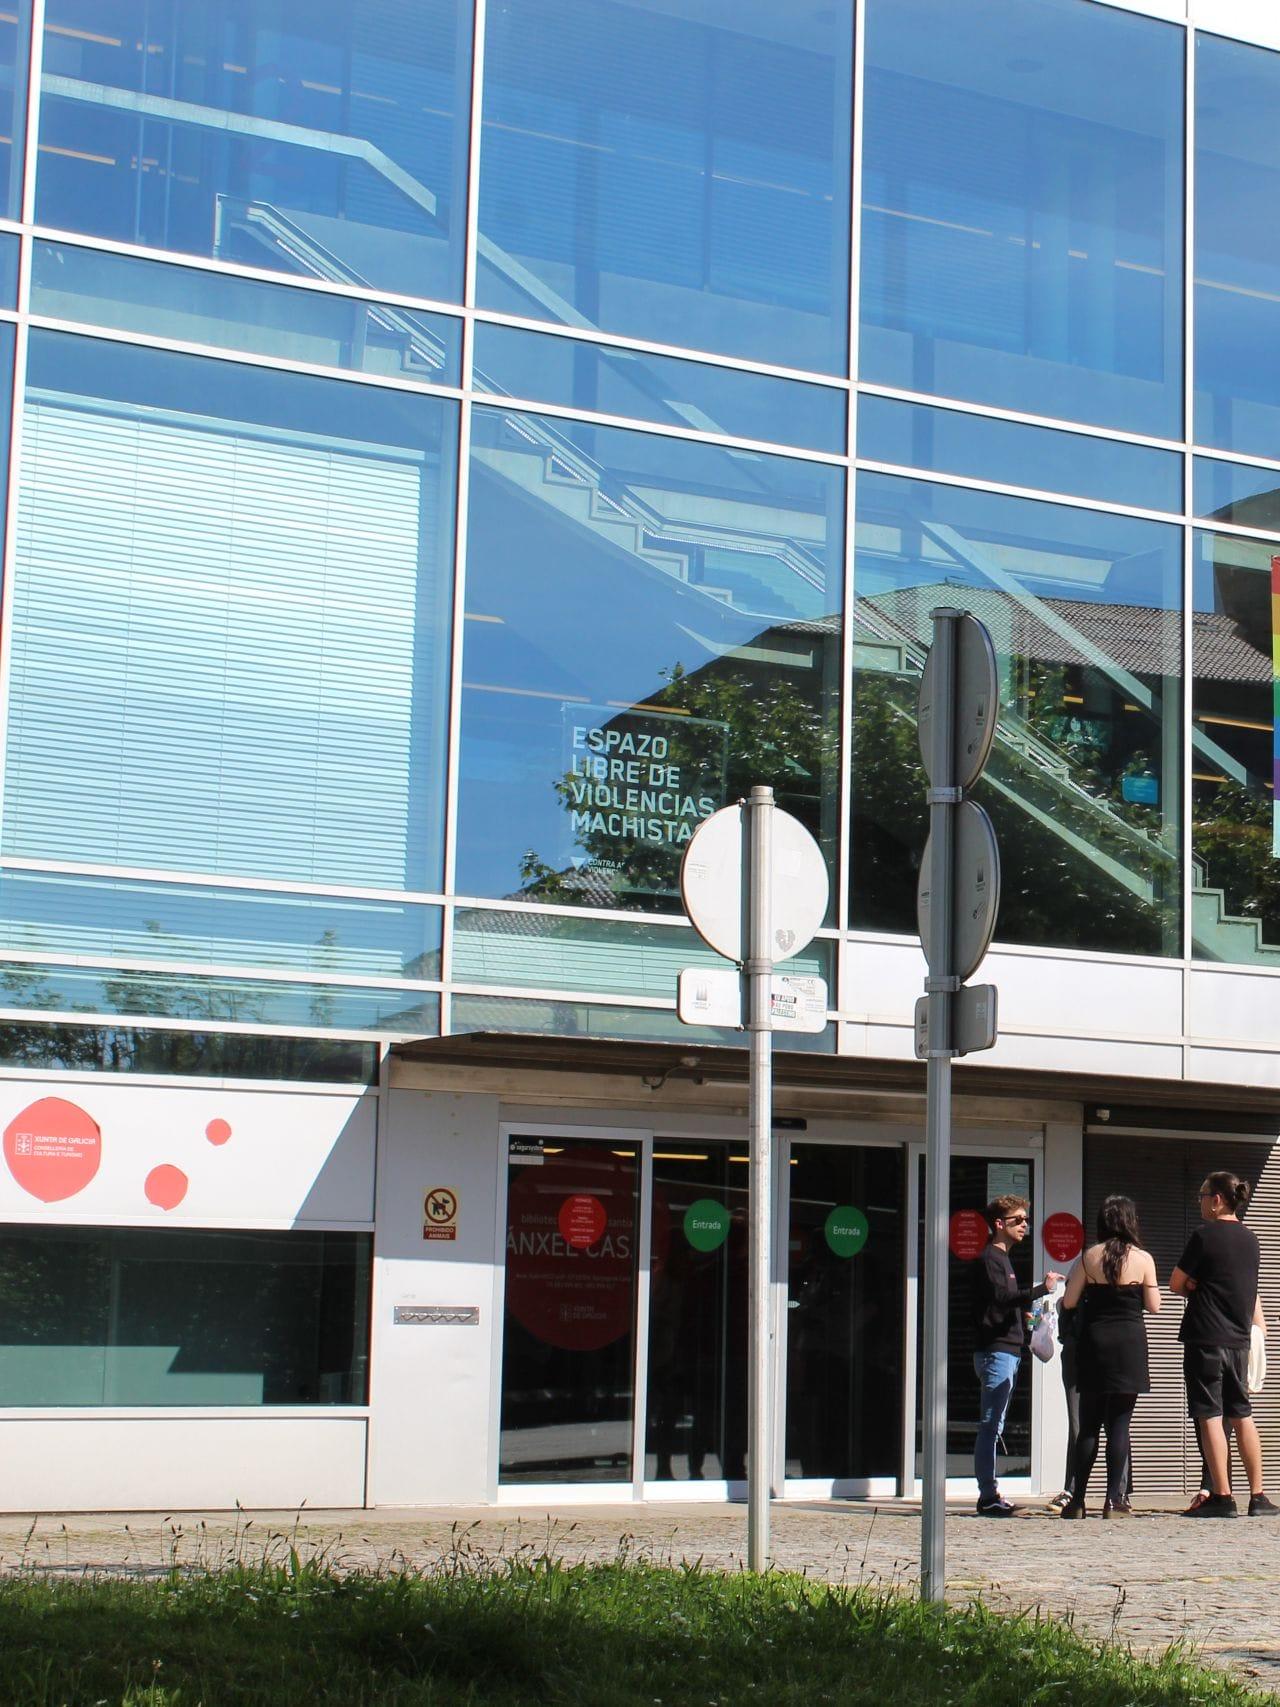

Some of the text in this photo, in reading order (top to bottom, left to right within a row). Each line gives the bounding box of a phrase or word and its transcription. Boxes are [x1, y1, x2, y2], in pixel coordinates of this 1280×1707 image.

[572, 726, 668, 759] ESPAZO
[572, 754, 680, 788] LIBRE DE
[570, 781, 715, 818] VIOLENCIAS
[571, 809, 700, 843] MACHISTA
[587, 858, 615, 868] CONTRA
[692, 1219, 721, 1230] Entrada
[833, 1225, 861, 1236] Entrada
